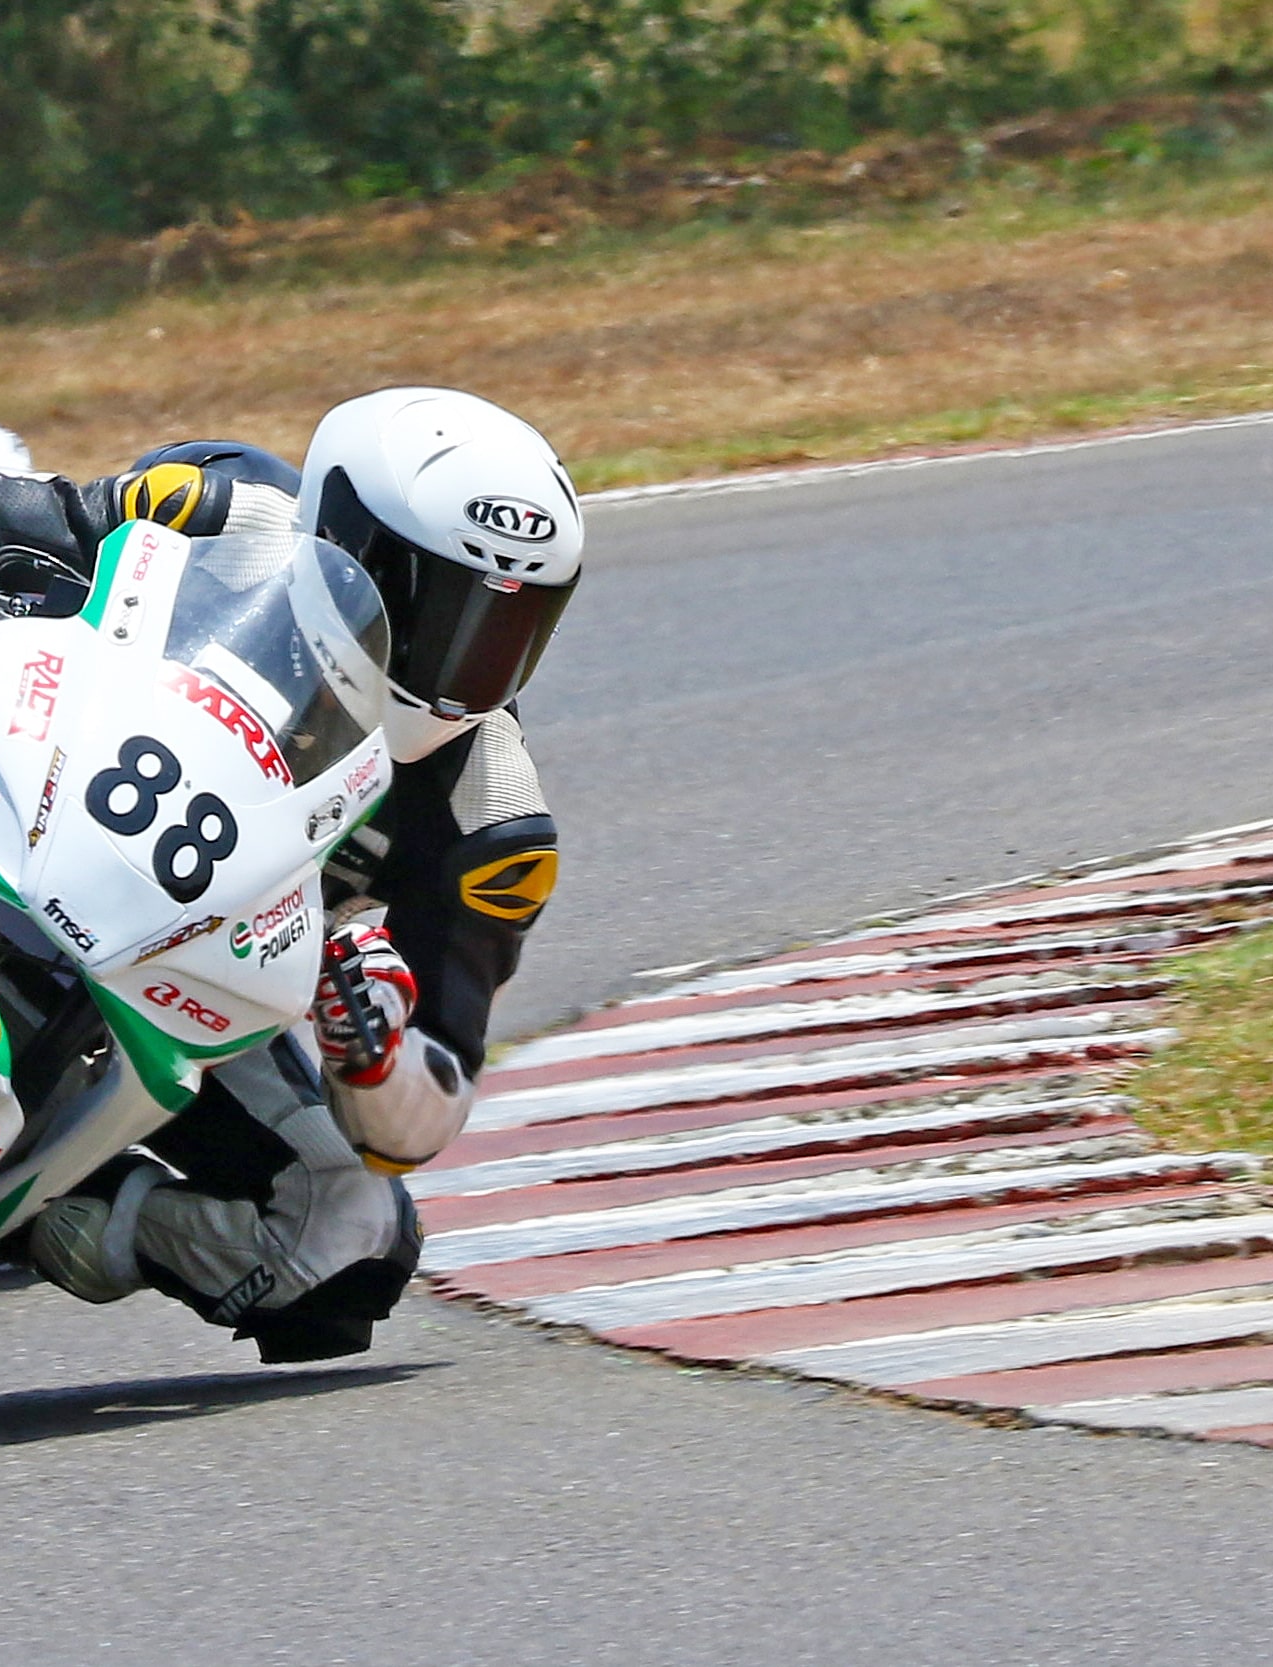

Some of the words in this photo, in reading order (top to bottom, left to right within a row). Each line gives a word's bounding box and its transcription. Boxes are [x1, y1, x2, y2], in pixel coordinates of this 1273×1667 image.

[467, 500, 551, 536] KYT
[164, 665, 295, 788] MRF
[84, 735, 238, 904] 88
[253, 884, 304, 938] Castrol
[178, 998, 231, 1032] RCB
